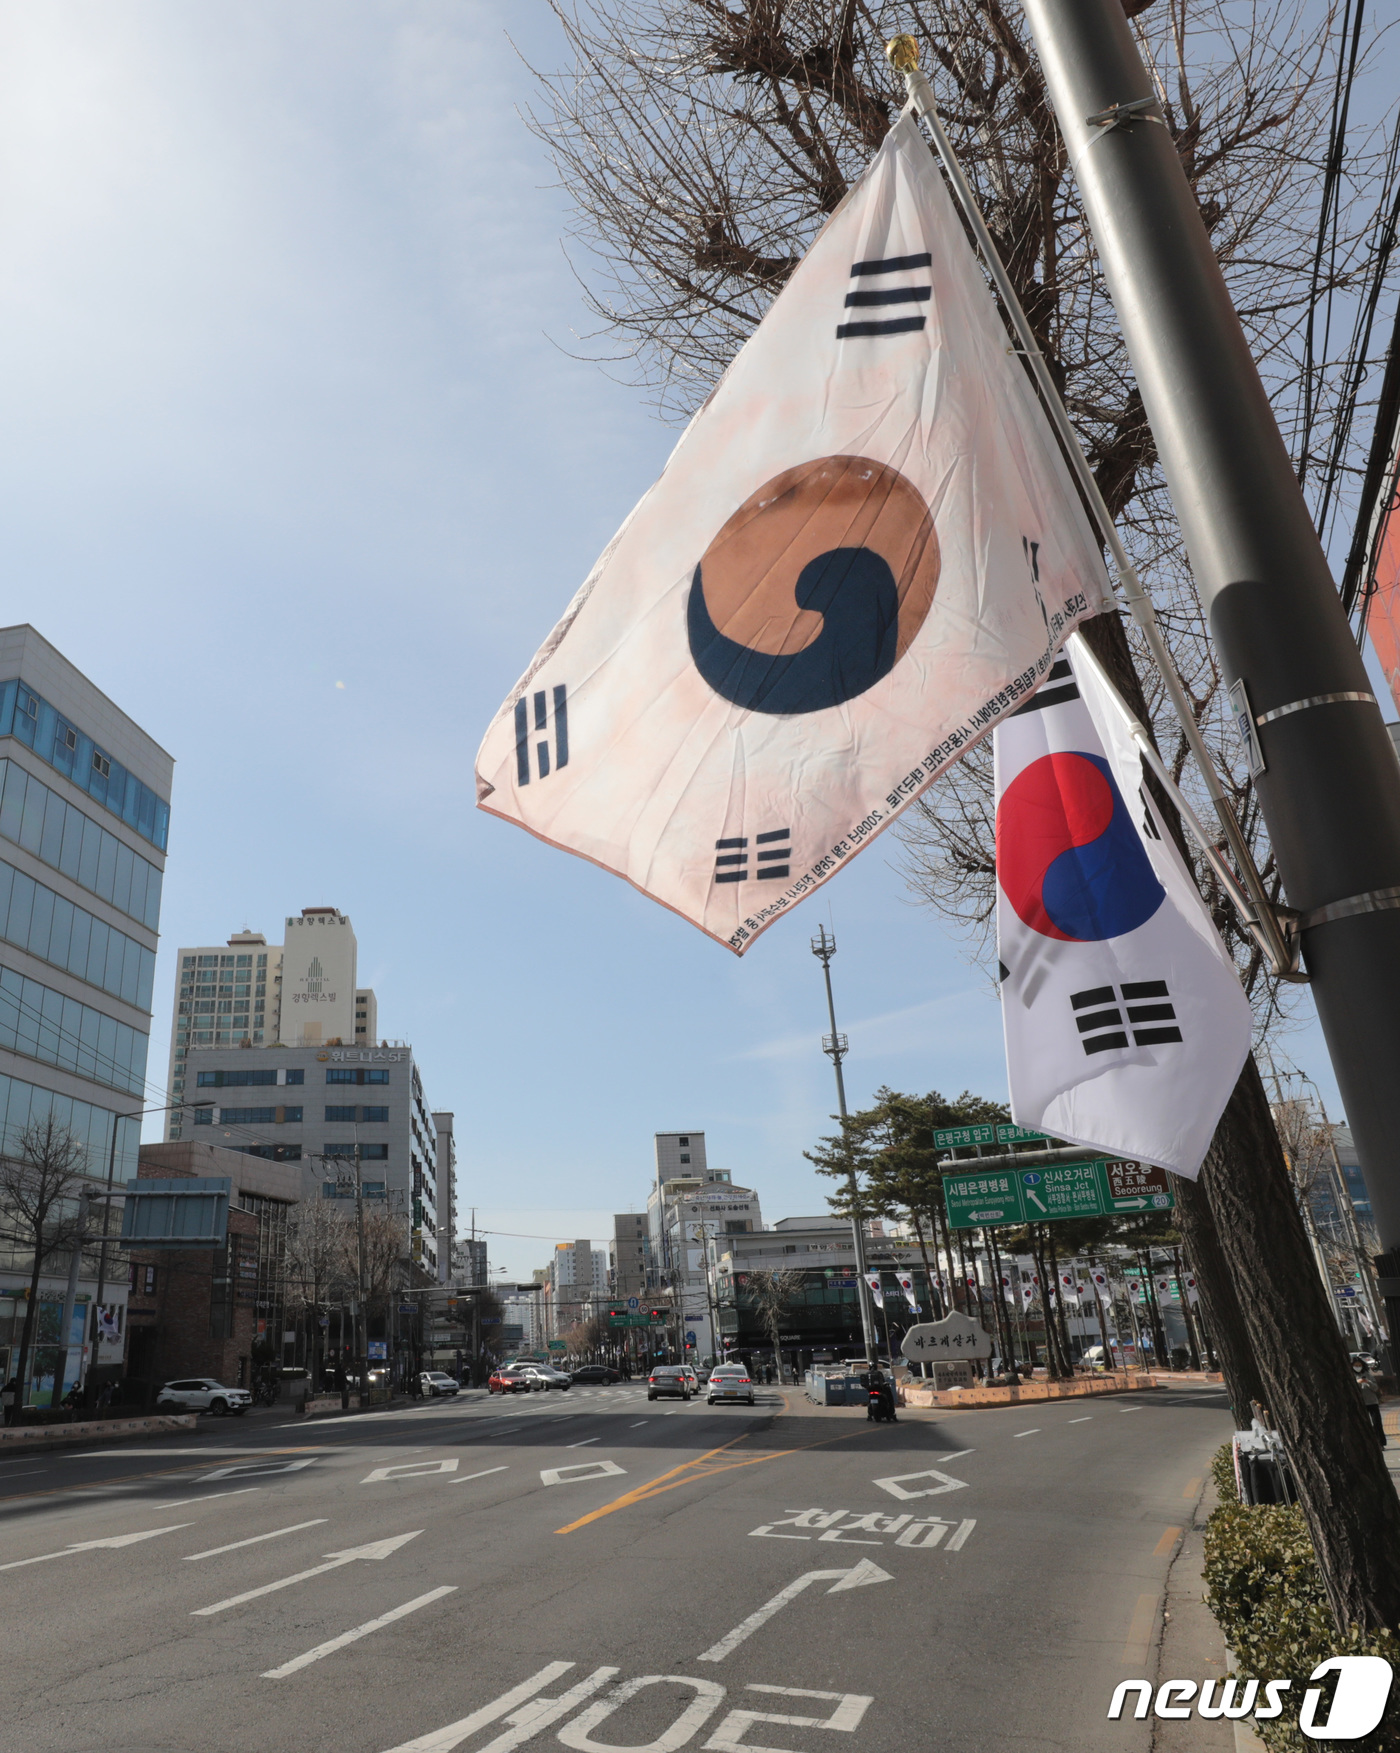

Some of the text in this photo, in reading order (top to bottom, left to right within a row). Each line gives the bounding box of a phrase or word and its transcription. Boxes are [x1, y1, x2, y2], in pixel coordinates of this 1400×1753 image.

[937, 1127, 990, 1145] 은평구청 입구
[1044, 1167, 1094, 1184] 신사오거리
[1111, 1162, 1152, 1176] 서오릉
[949, 1178, 1009, 1196] 시립은평병원
[1045, 1181, 1089, 1193] Sinsa Jct
[1114, 1184, 1163, 1195] Seooreung
[1155, 1197, 1166, 1206] 20
[747, 1508, 977, 1551] 천천히
